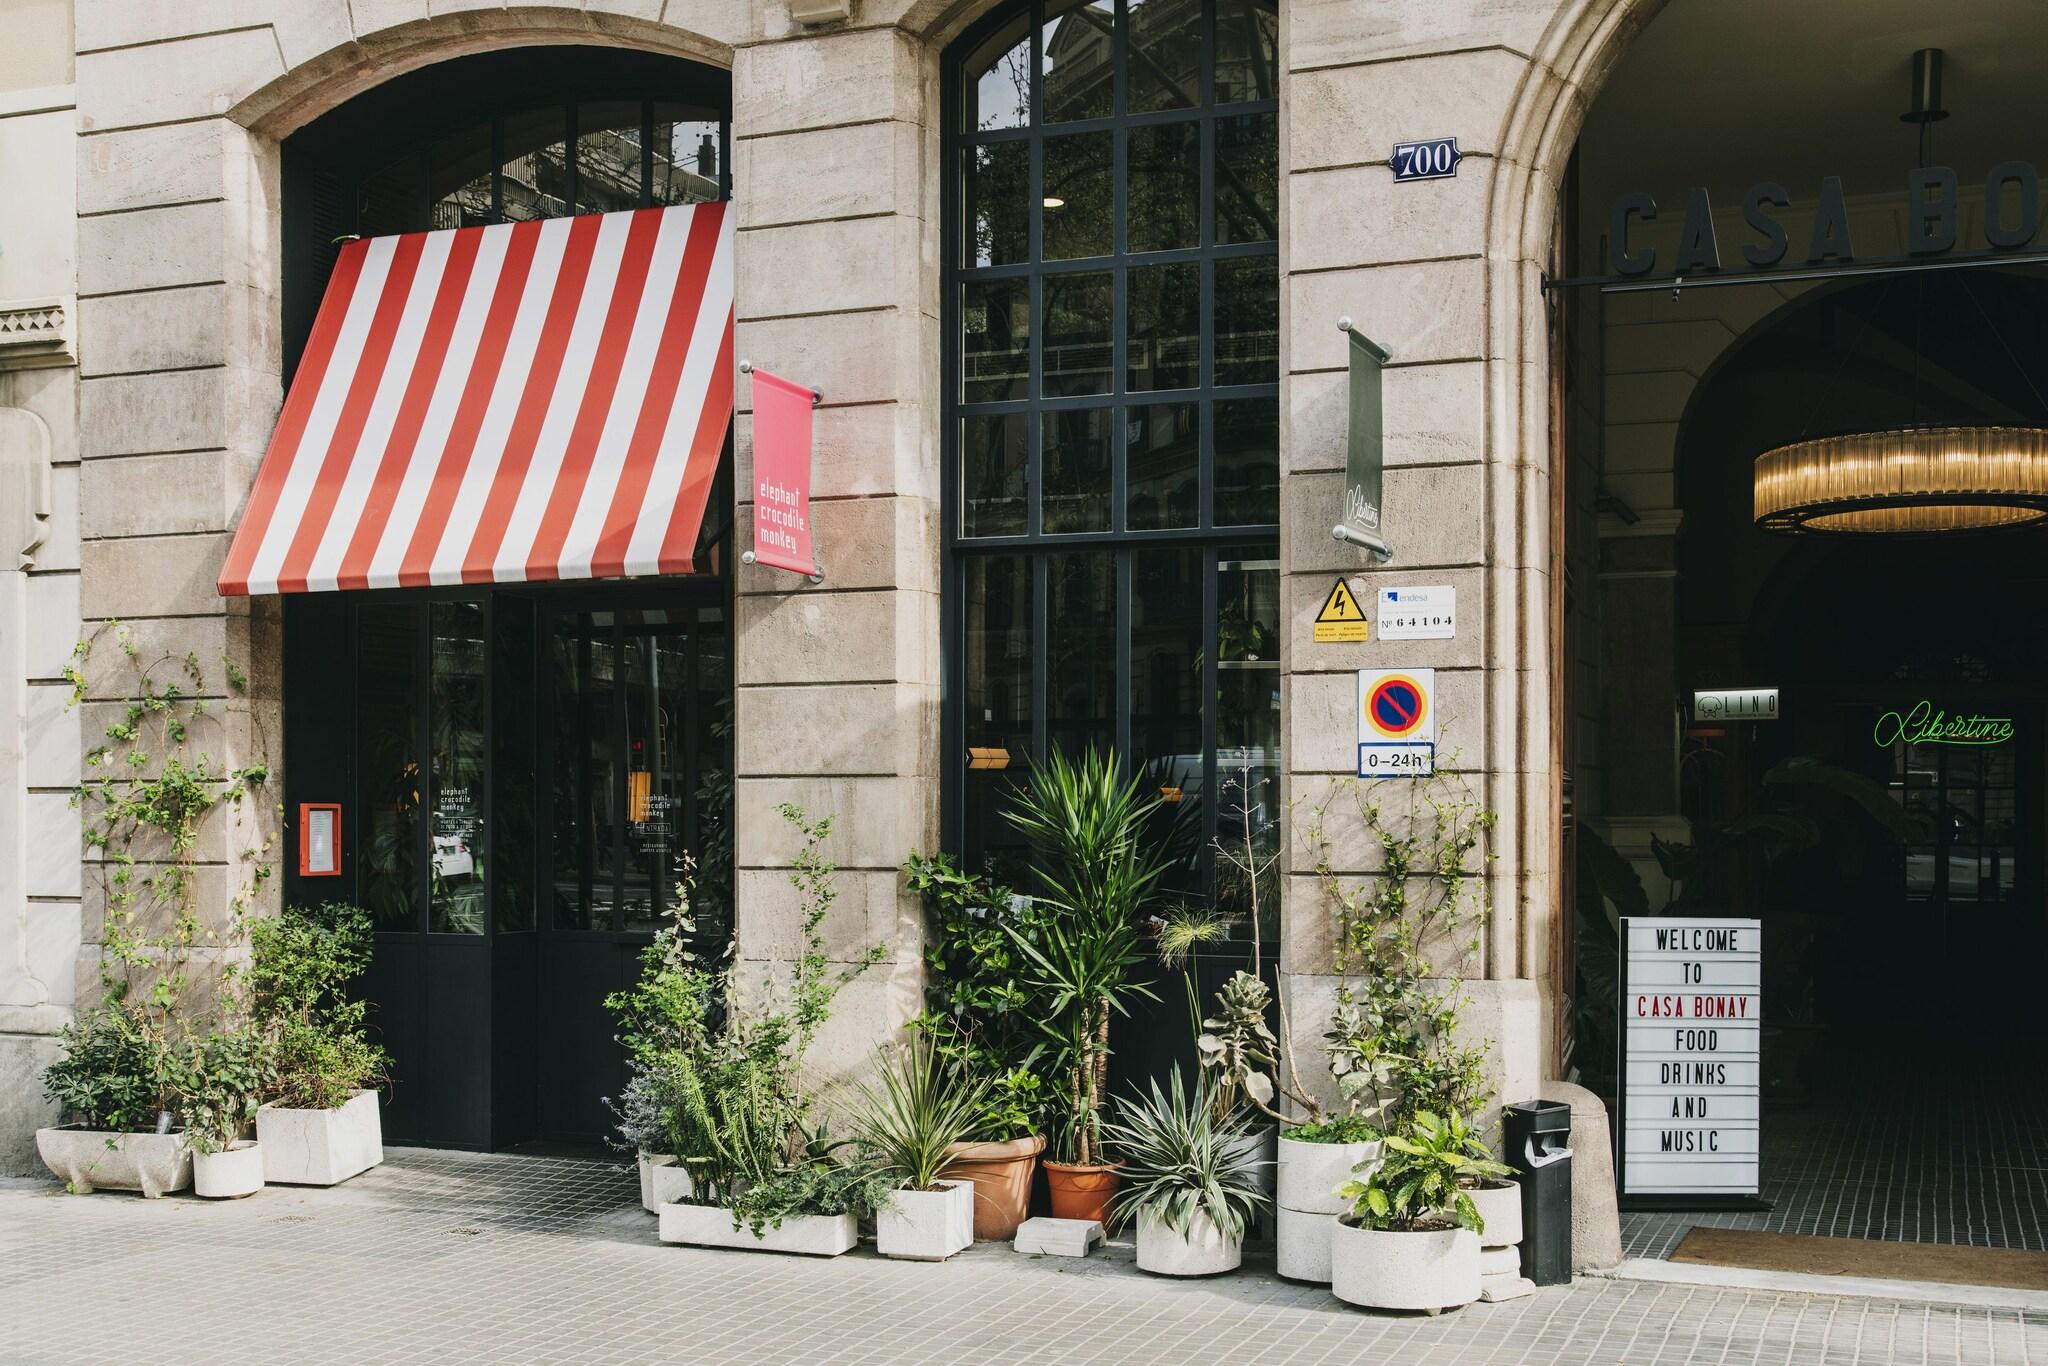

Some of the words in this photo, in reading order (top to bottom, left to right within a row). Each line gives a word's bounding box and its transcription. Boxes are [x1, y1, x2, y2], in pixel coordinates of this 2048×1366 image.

[1399, 143, 1451, 176] 700
[1610, 176, 1855, 275] CASA
[1909, 161, 2038, 255] BO
[760, 476, 800, 507] elephant
[760, 505, 804, 531] crocodile
[761, 526, 797, 554] monkey
[1725, 695, 1775, 712] LINO
[1875, 700, 2014, 747] Libertine
[440, 786, 468, 797] elephant
[440, 794, 470, 803] crocodile
[1656, 929, 1738, 951] WELCOME
[1683, 963, 1702, 984] TO
[1638, 996, 1683, 1017] CASA
[1694, 996, 1747, 1018] BONAY
[1676, 1030, 1717, 1051] FOOD
[1661, 1063, 1726, 1084] DRINKS
[1672, 1097, 1707, 1118] AND
[1661, 1130, 1718, 1152] MUSIC
